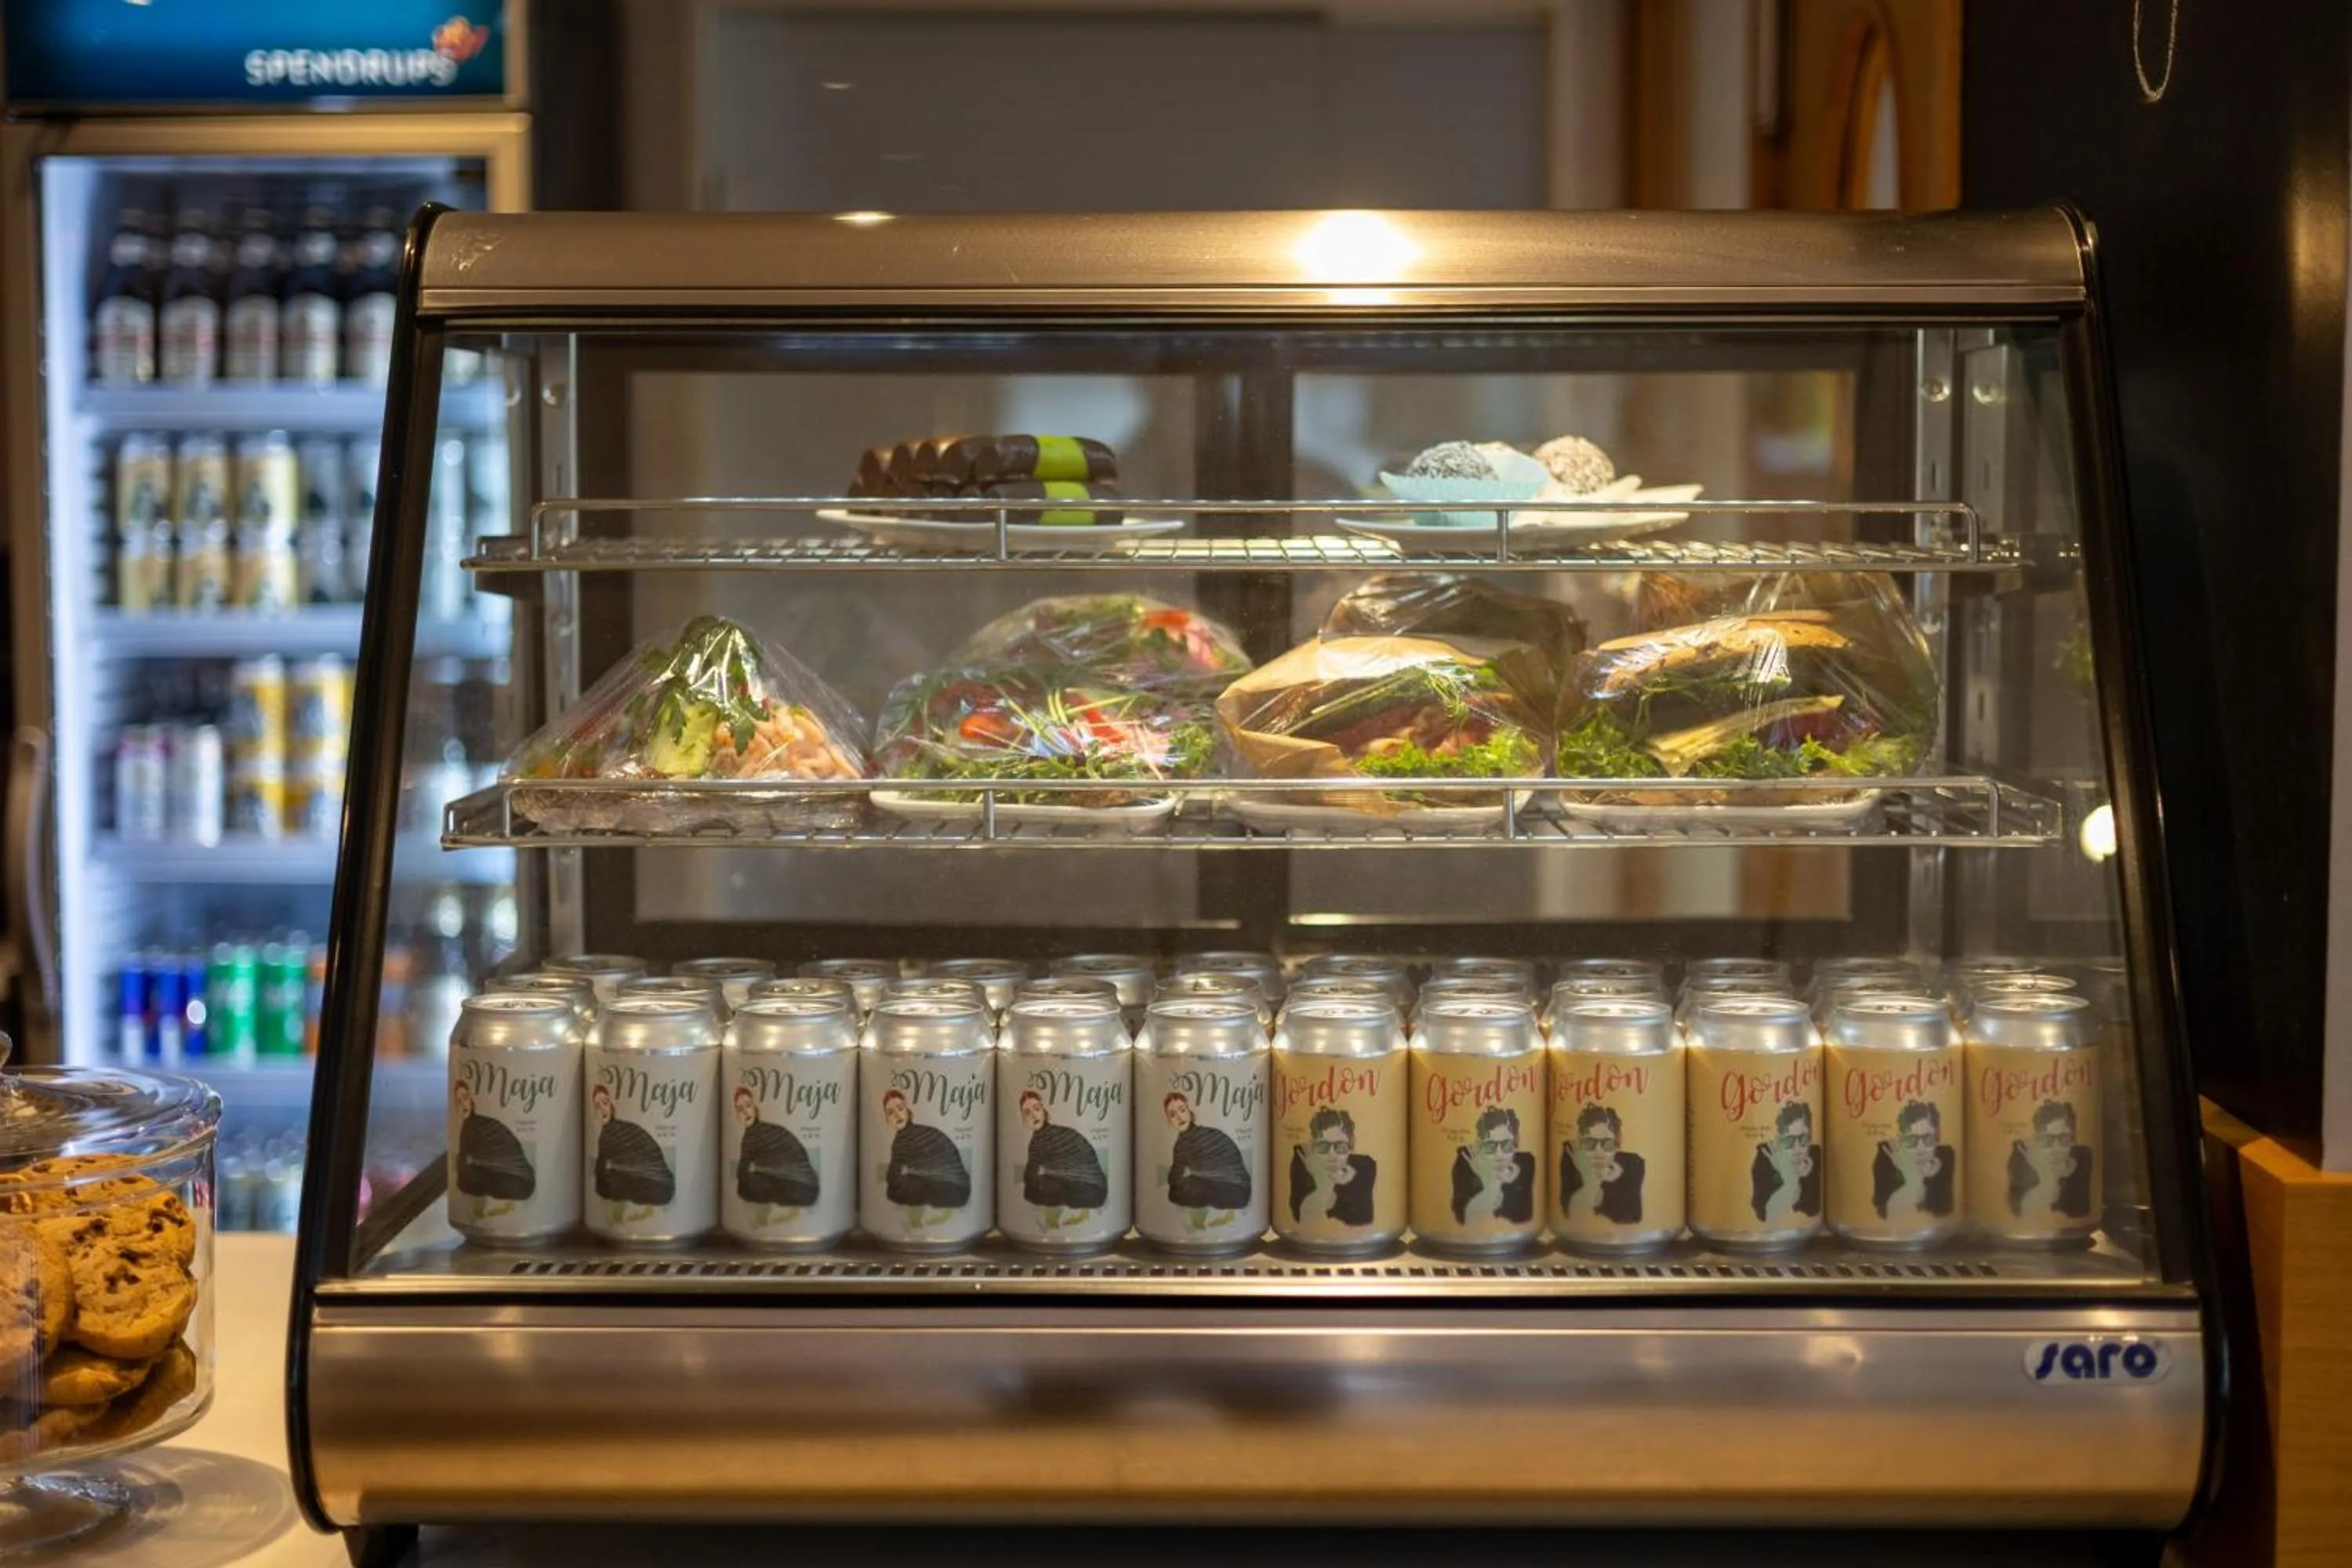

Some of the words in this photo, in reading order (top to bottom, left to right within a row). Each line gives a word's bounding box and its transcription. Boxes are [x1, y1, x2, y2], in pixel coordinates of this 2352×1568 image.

[244, 49, 458, 86] SPENDRUPS
[461, 1059, 559, 1114] Maja
[597, 1063, 697, 1118] Maja
[740, 1066, 840, 1119] Maja
[891, 1069, 989, 1121] Maja
[1027, 1069, 1125, 1121] Maja
[1171, 1070, 1265, 1122] Maja
